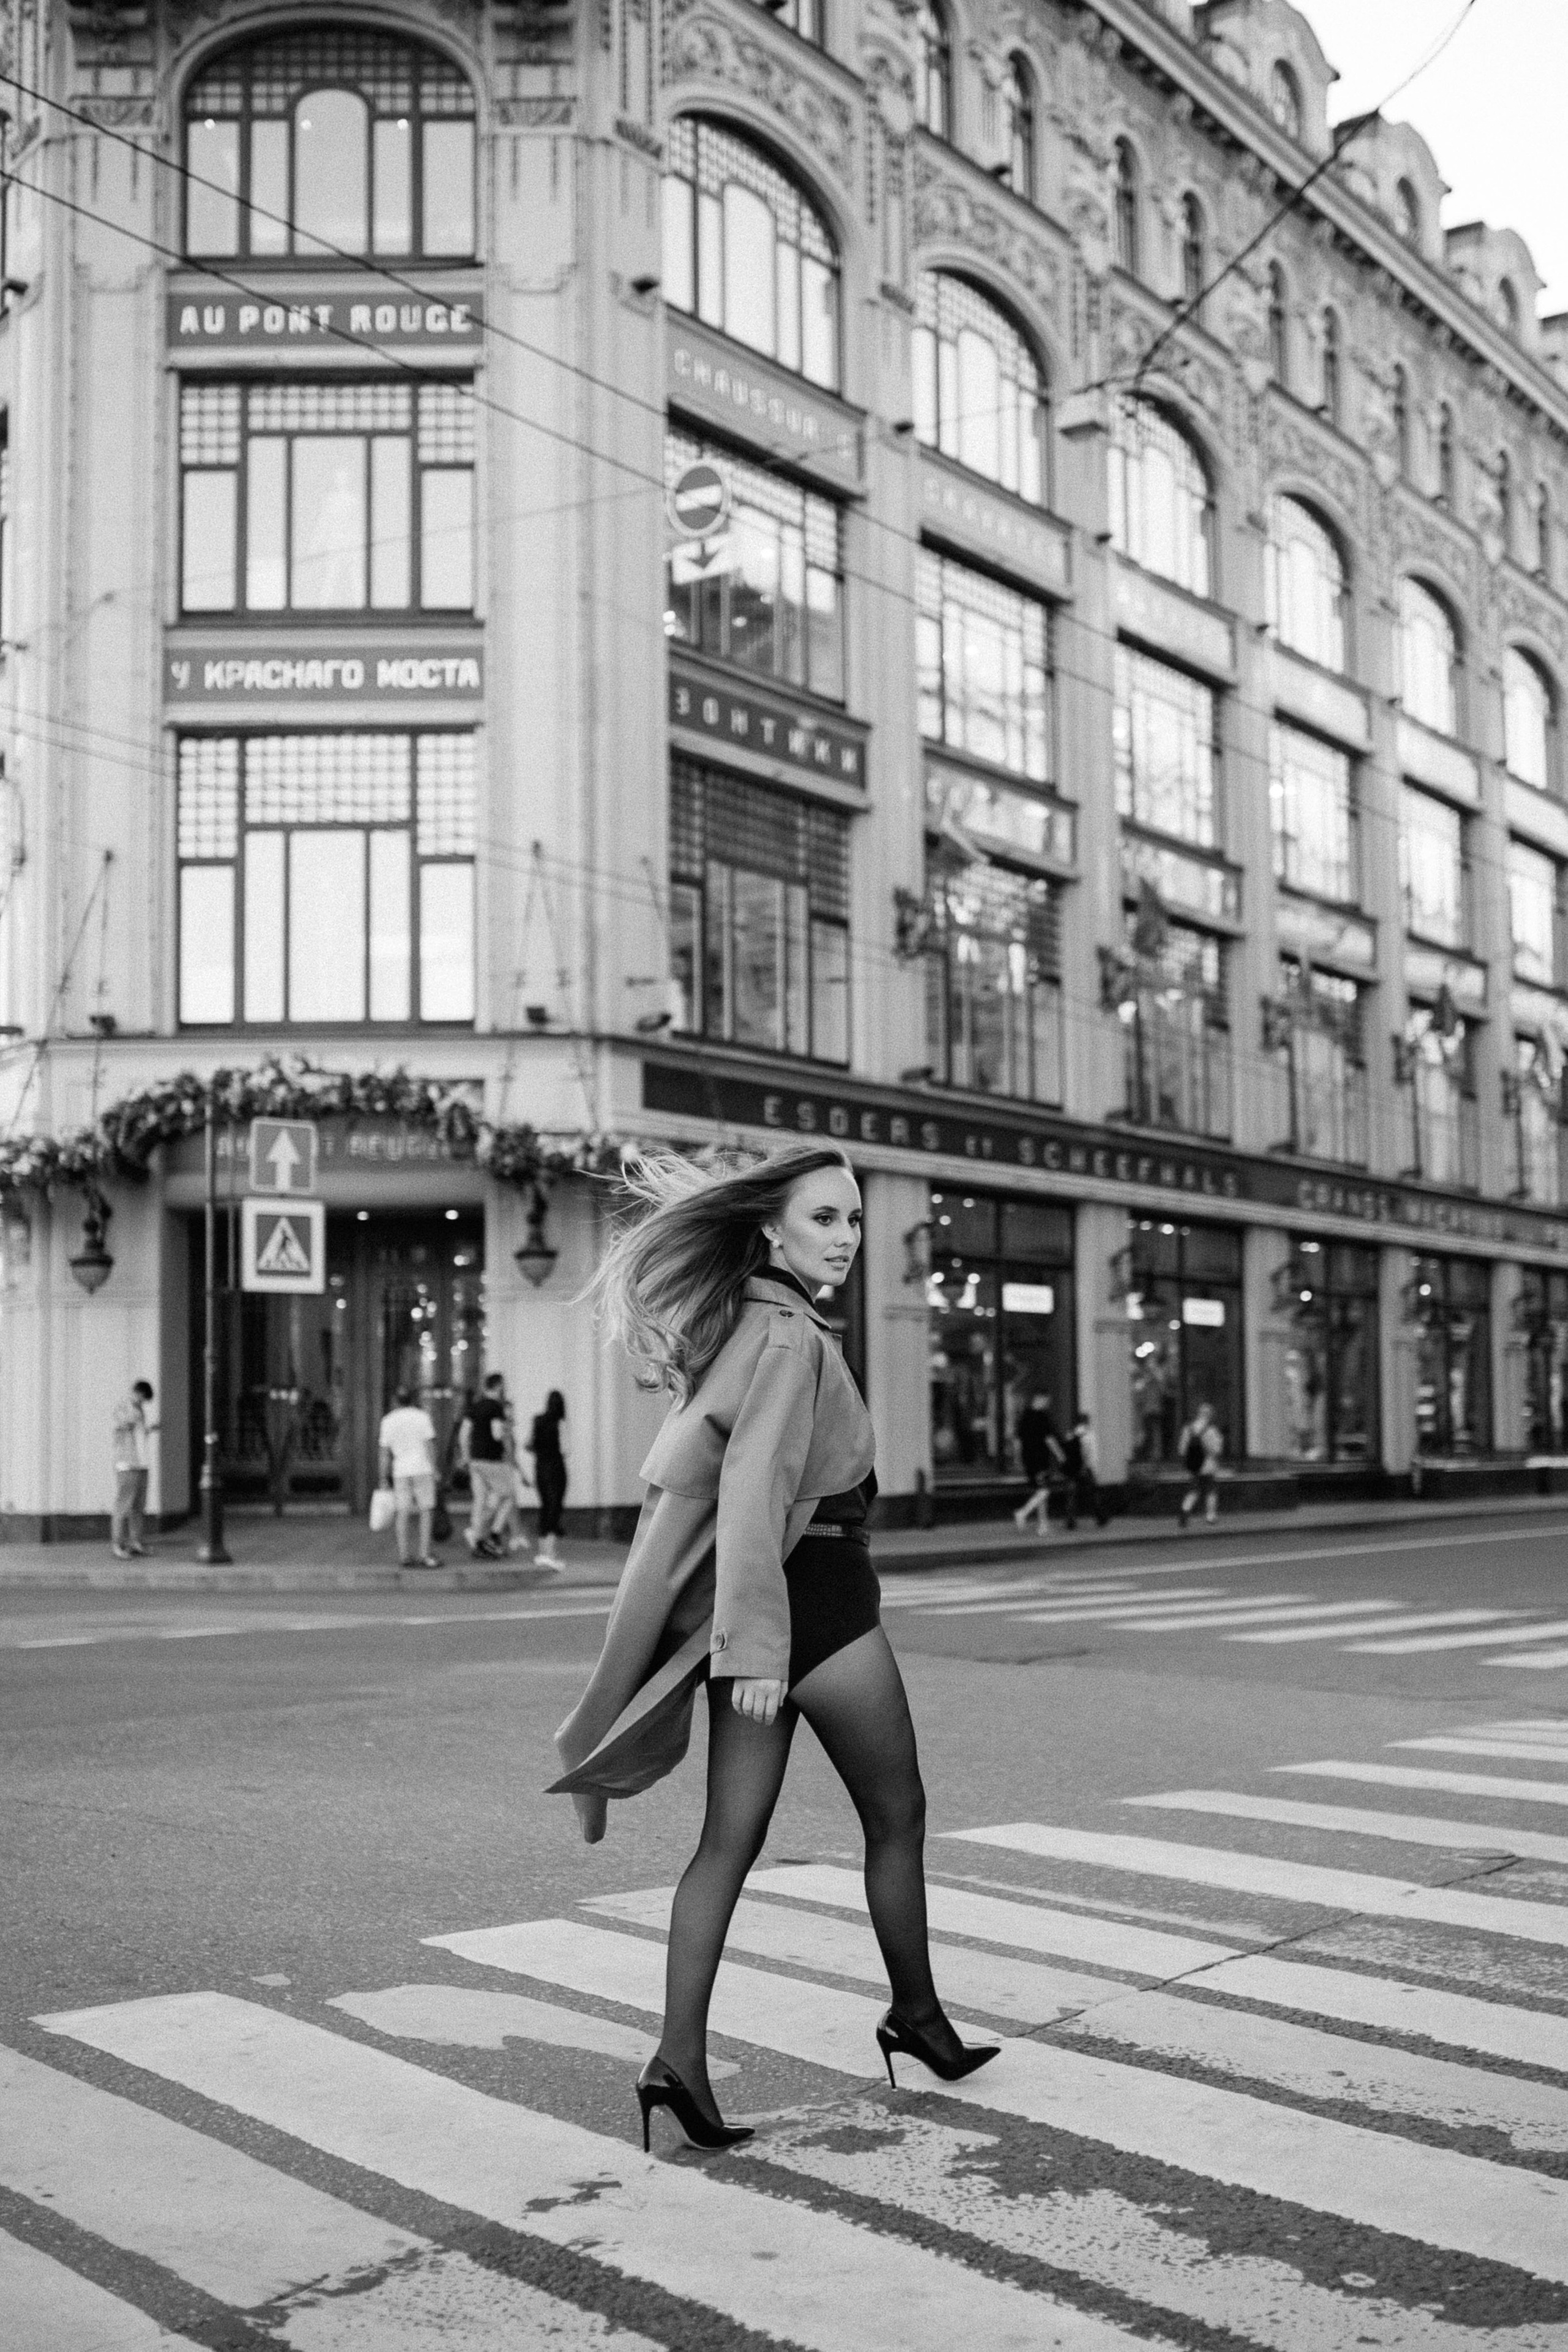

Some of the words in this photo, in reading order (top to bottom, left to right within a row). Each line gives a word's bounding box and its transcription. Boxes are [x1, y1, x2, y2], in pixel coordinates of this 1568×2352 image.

[180, 305, 225, 334] AU
[239, 305, 331, 334] PONT
[350, 305, 472, 333] ROUGE
[172, 661, 190, 688] У
[205, 658, 364, 690] КРАСНАГО
[376, 658, 480, 688] МОСТА
